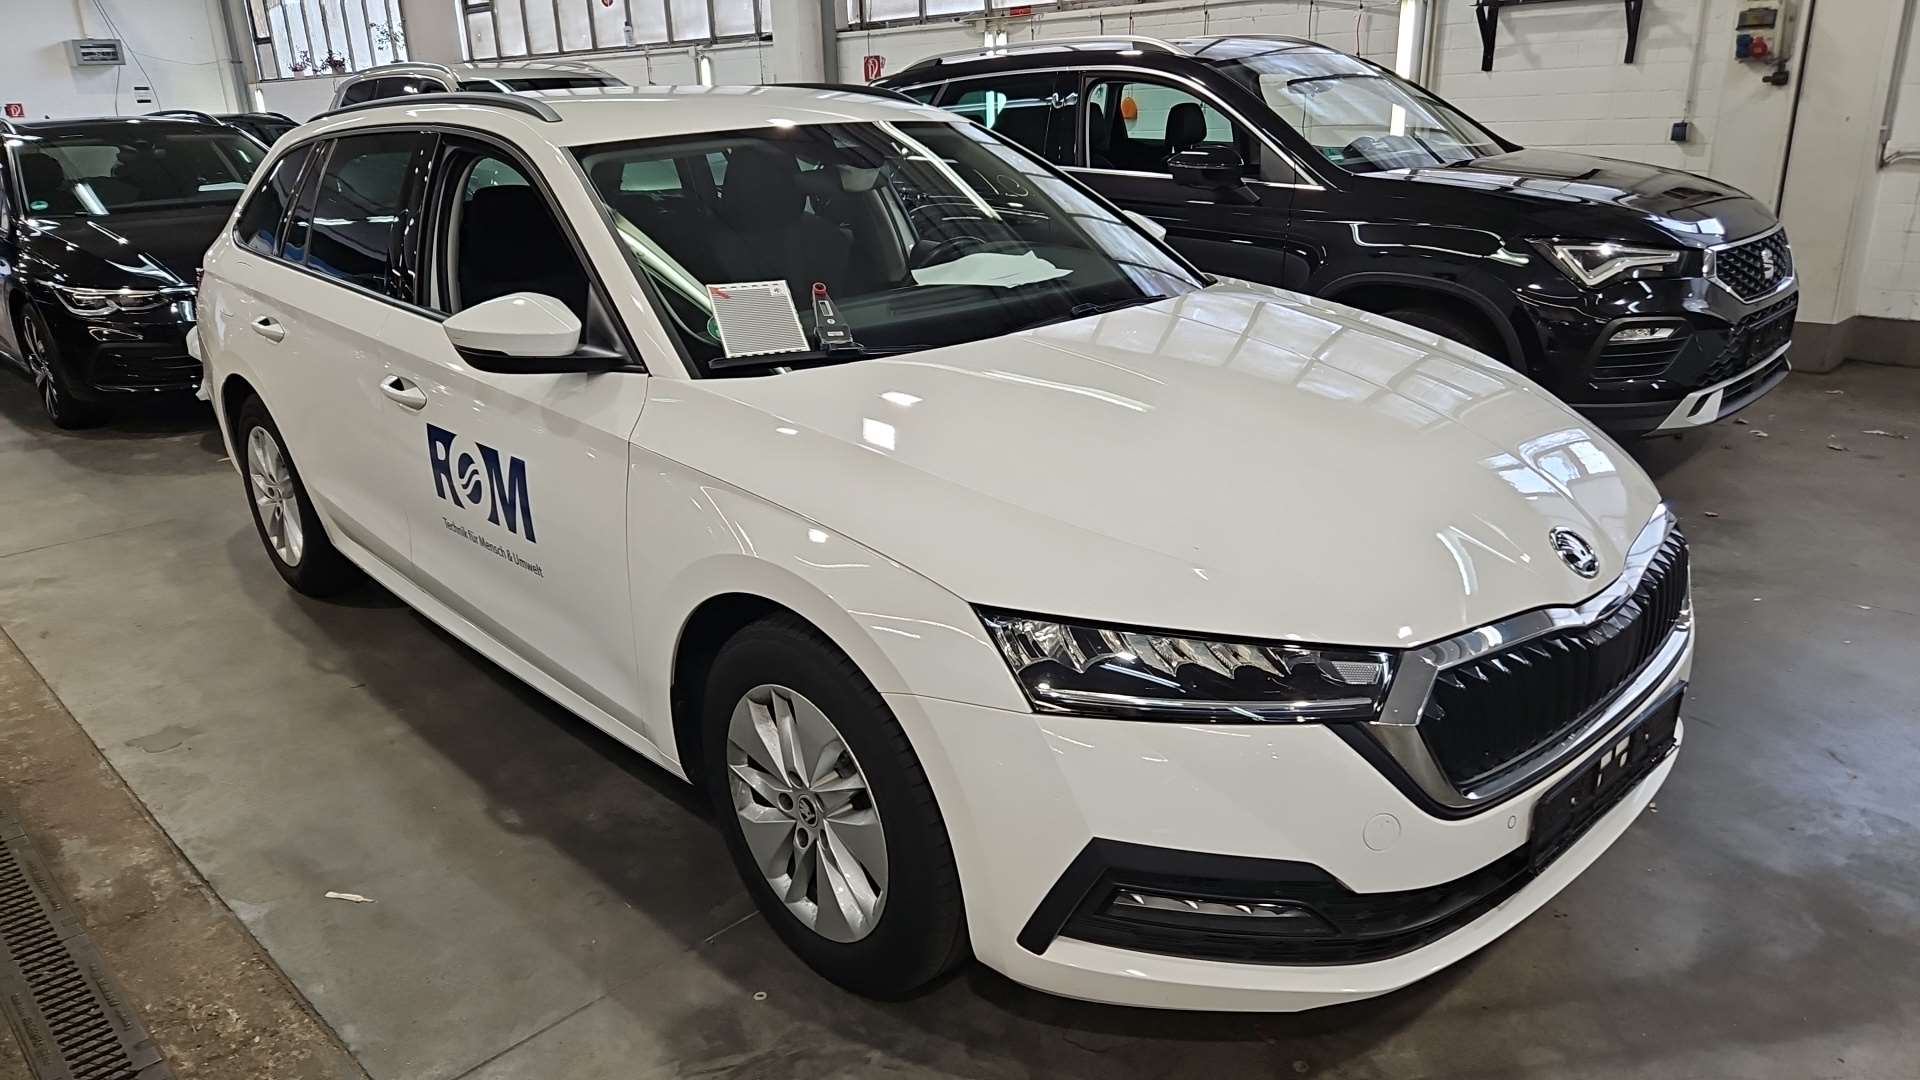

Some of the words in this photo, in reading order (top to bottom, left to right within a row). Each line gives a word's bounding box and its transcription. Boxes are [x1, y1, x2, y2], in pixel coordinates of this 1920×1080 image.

[442, 516, 468, 538] Technik
[467, 529, 479, 544] für
[478, 535, 507, 559] Mensch
[506, 549, 513, 562] &
[512, 552, 544, 578] Umwelt
